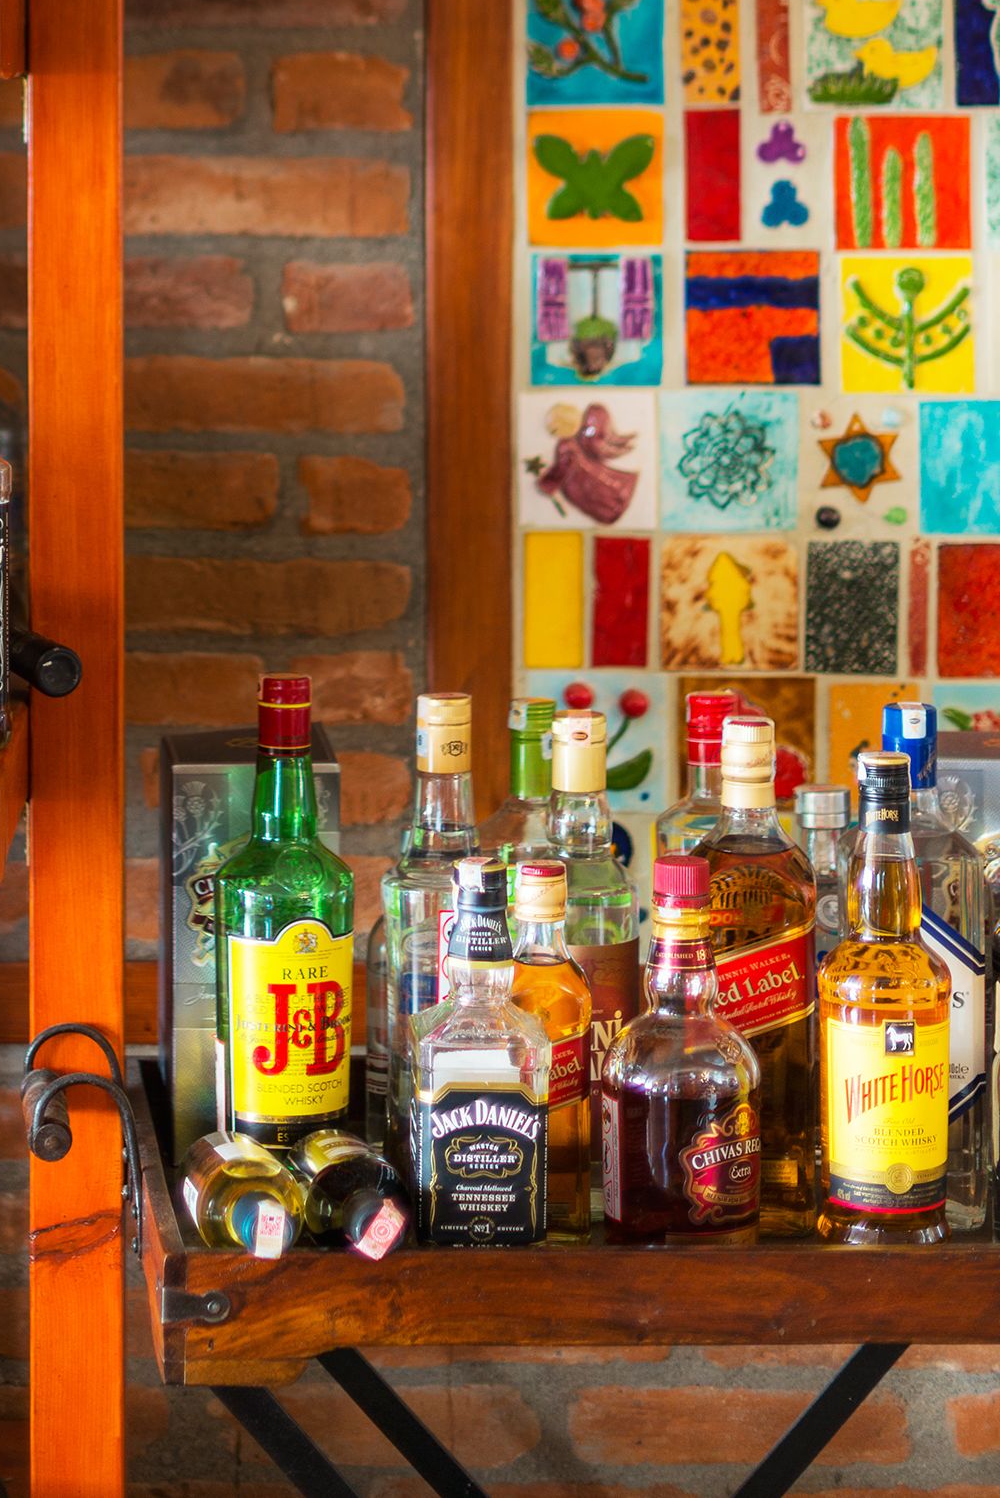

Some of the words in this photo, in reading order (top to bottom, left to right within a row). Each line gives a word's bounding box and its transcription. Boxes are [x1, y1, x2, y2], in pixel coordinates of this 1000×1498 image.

[282, 965, 329, 980] RARE
[718, 967, 748, 983] HNNIE
[714, 988, 743, 1009] ed
[252, 980, 345, 1076] J&B
[256, 1083, 305, 1094] BLENDED
[307, 1078, 343, 1093] SCOTCH
[844, 1072, 899, 1125] WHITE
[900, 1062, 945, 1103] HORSE
[283, 1094, 325, 1106] WHISKY
[430, 1105, 475, 1140] JACK
[474, 1098, 542, 1141] DANIEL'S
[873, 1127, 925, 1137] BLENDED
[468, 1142, 500, 1152] MASTER
[855, 1134, 899, 1147] SCOTCH
[900, 1134, 938, 1147] WHISKY
[453, 1153, 516, 1164] DISTILLER
[691, 1142, 743, 1171] CHIVAS
[730, 1165, 752, 1180] Extra
[455, 1184, 483, 1192] Charcoal
[482, 1183, 513, 1192] Mellowed
[451, 1193, 517, 1202] TENNESSEE
[459, 1203, 509, 1212] WHISKEY
